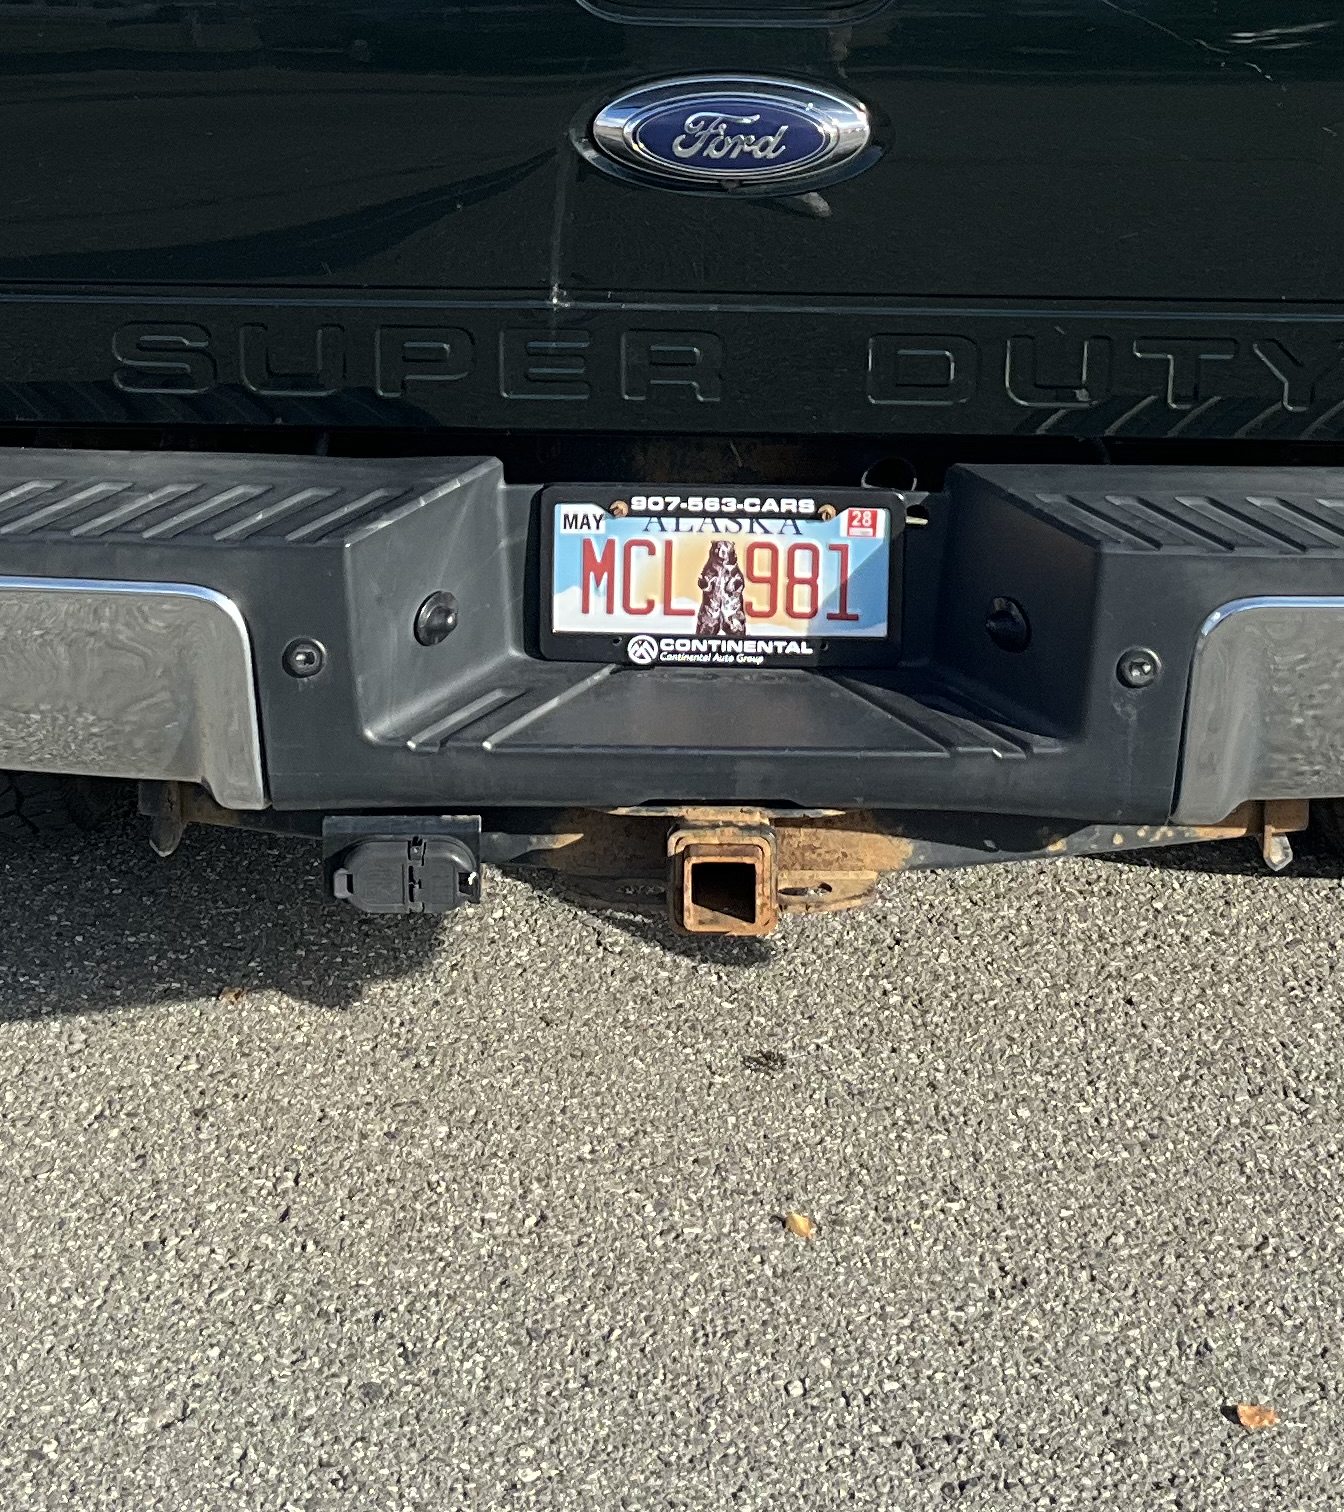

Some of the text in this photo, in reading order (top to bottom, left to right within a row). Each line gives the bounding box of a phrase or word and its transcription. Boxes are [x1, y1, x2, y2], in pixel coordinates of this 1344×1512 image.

[671, 111, 788, 160] Ford
[112, 320, 725, 401] SUPER
[630, 496, 815, 513] 907-563-CARS
[562, 513, 605, 531] MAY
[642, 516, 803, 535] ALASKA
[851, 510, 872, 527] 28
[581, 538, 860, 622] MCL 981
[659, 638, 814, 655] CONTINENTAL
[659, 651, 764, 665] Continental Auto Group
